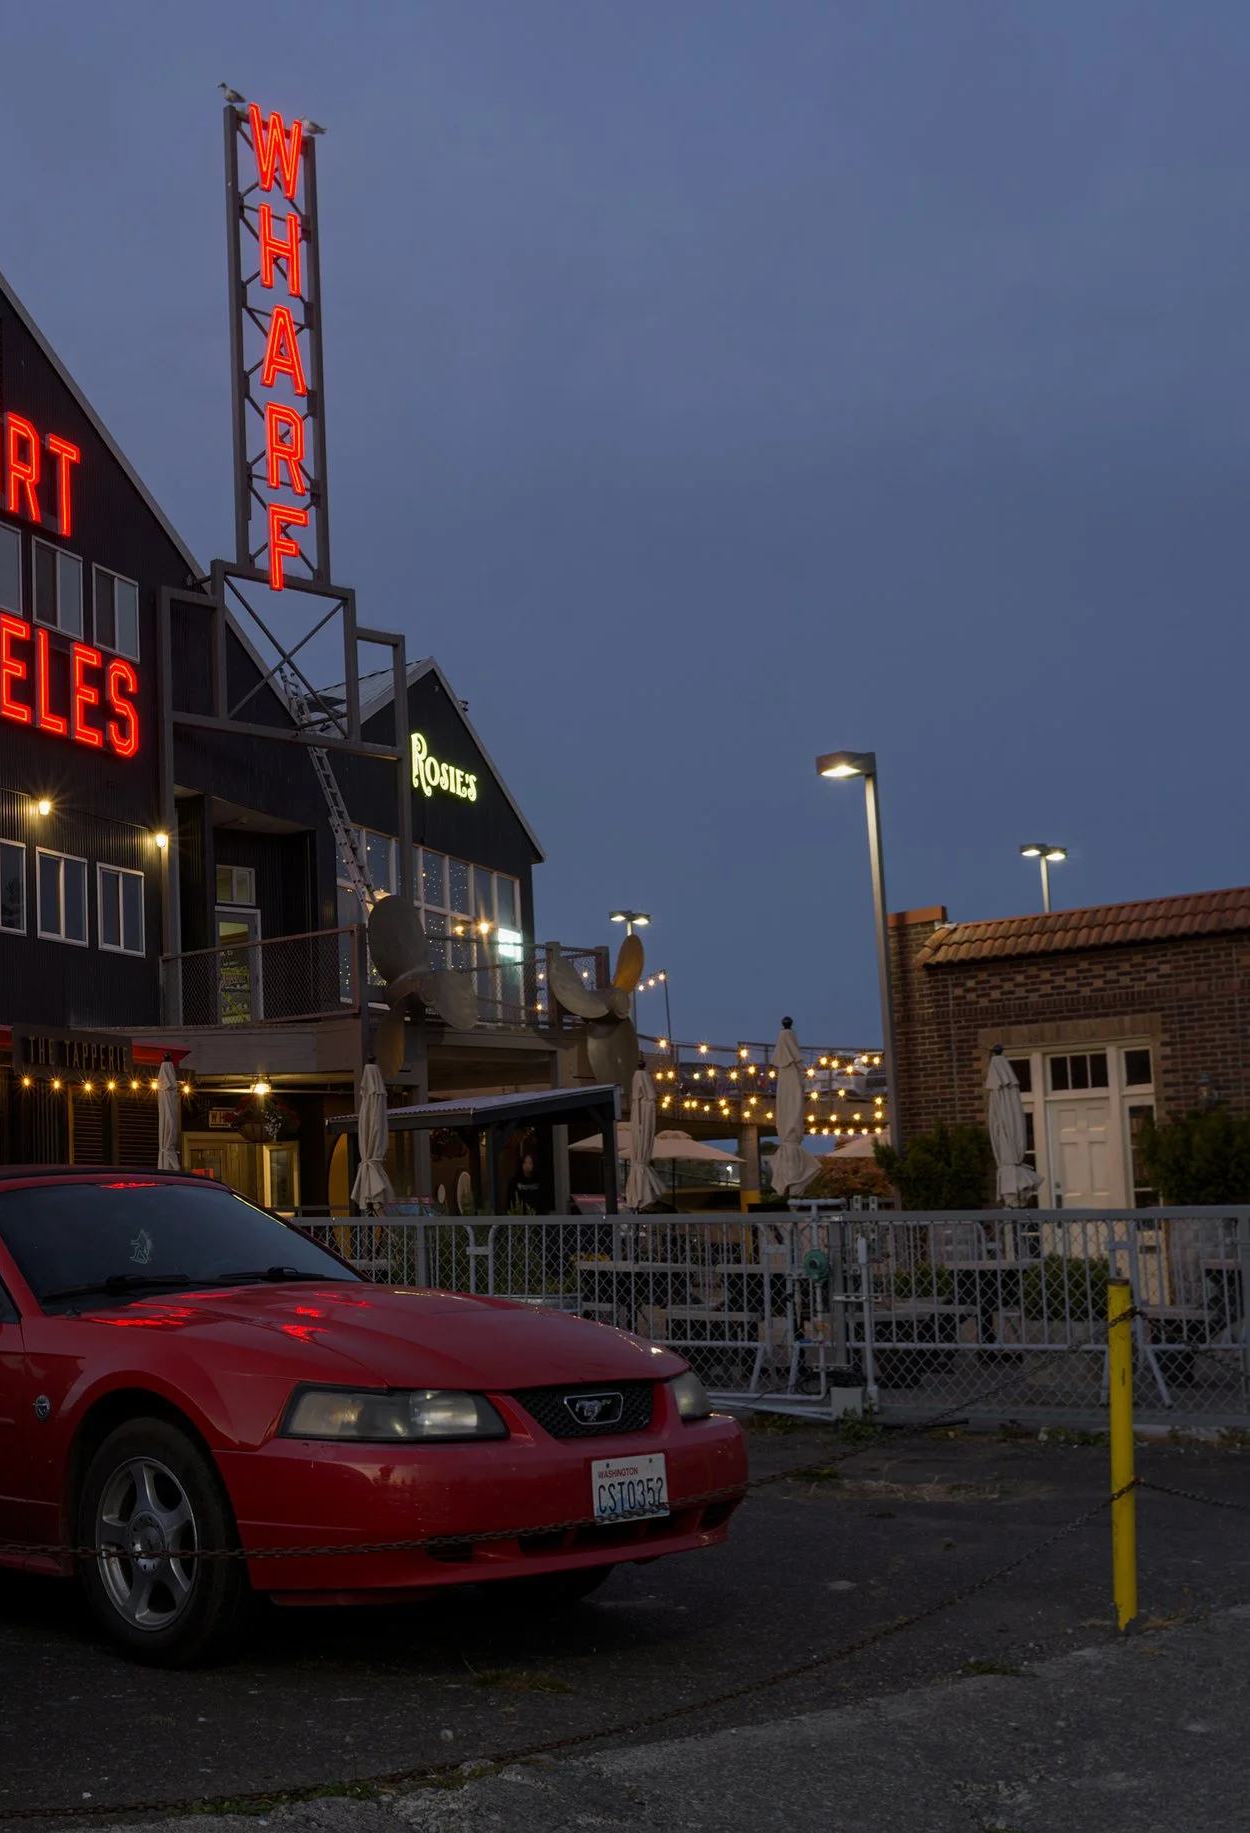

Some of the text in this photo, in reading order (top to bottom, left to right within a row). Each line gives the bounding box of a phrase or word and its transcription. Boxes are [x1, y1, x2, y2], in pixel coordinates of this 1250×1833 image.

[247, 103, 309, 591] WHARF
[411, 733, 477, 801] ROSIE'S
[27, 1035, 55, 1066] THE
[597, 1467, 639, 1479] WASHINGTON
[598, 1477, 664, 1514] CST0352
